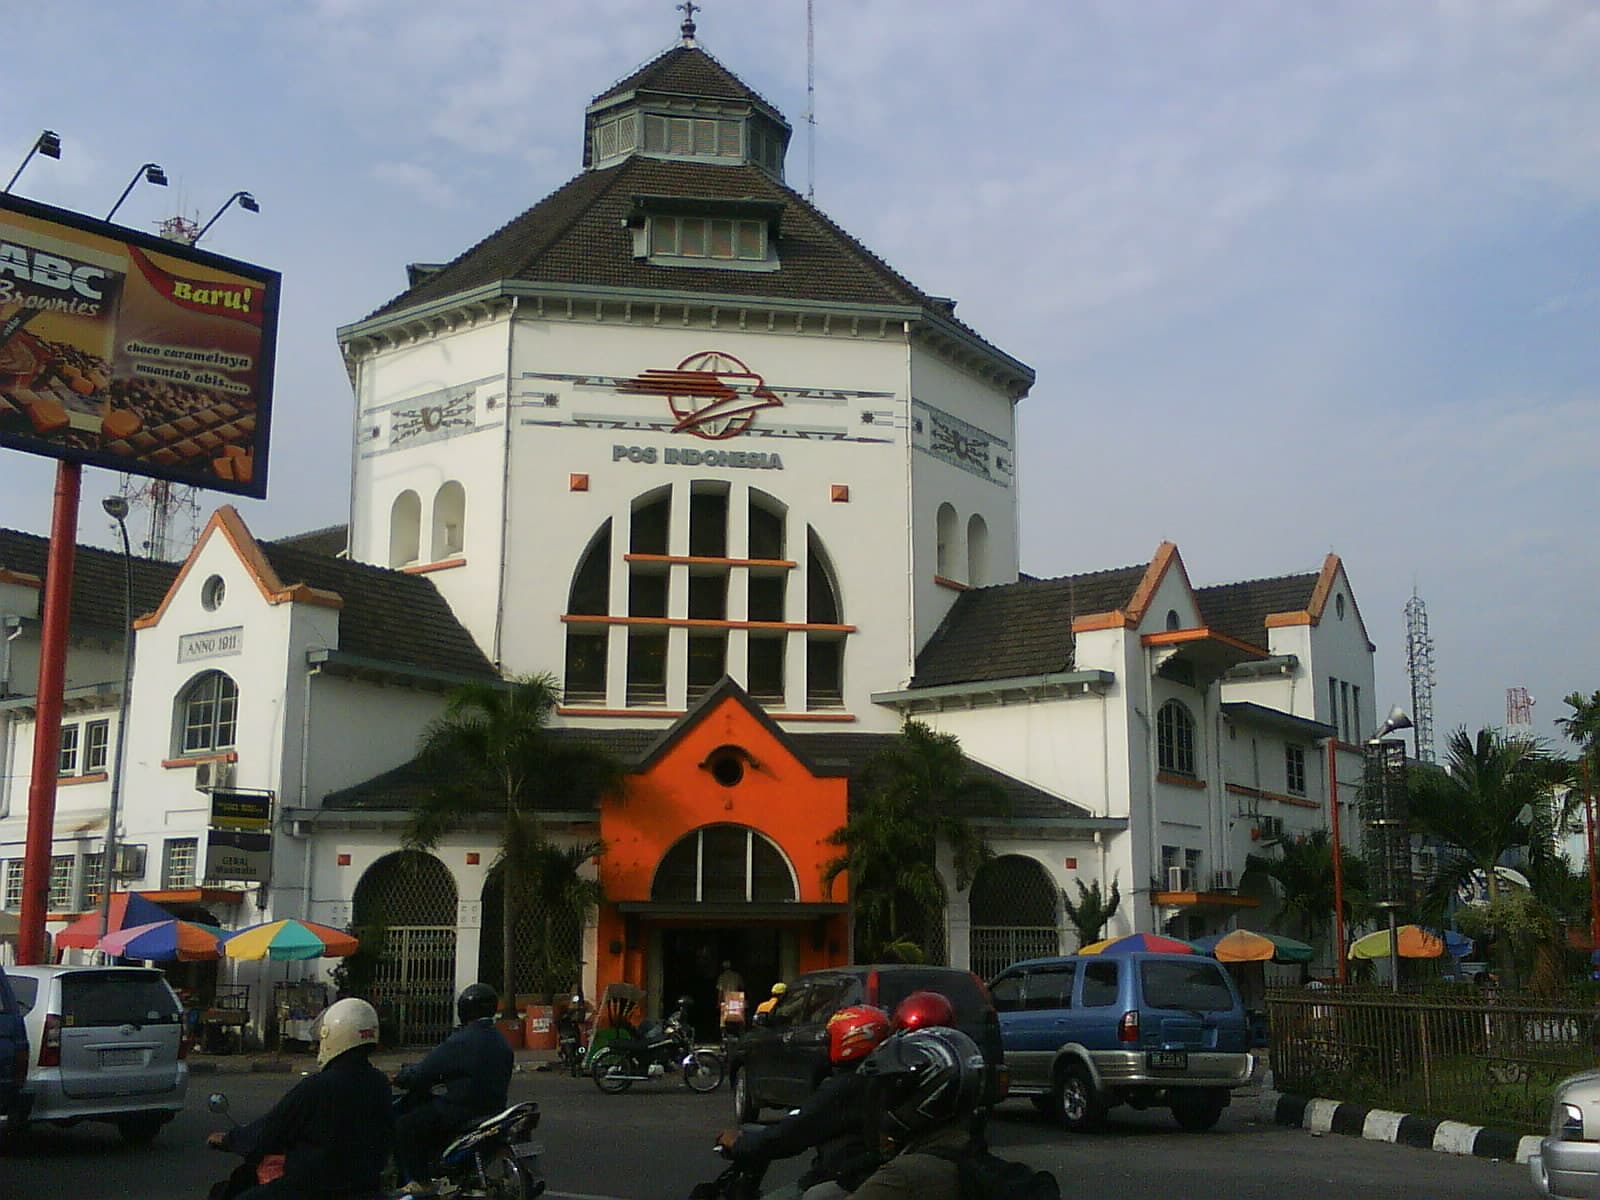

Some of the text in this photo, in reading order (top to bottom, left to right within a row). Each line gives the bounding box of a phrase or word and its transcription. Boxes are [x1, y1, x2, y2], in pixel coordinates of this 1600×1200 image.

[0, 243, 105, 301] ABC
[0, 279, 101, 317] Brownies
[174, 281, 252, 313] Baru!
[127, 342, 250, 368] choco caramelnya
[136, 363, 192, 382] muantab
[612, 444, 785, 471] POS INDONESIA
[186, 639, 216, 657] ANNO
